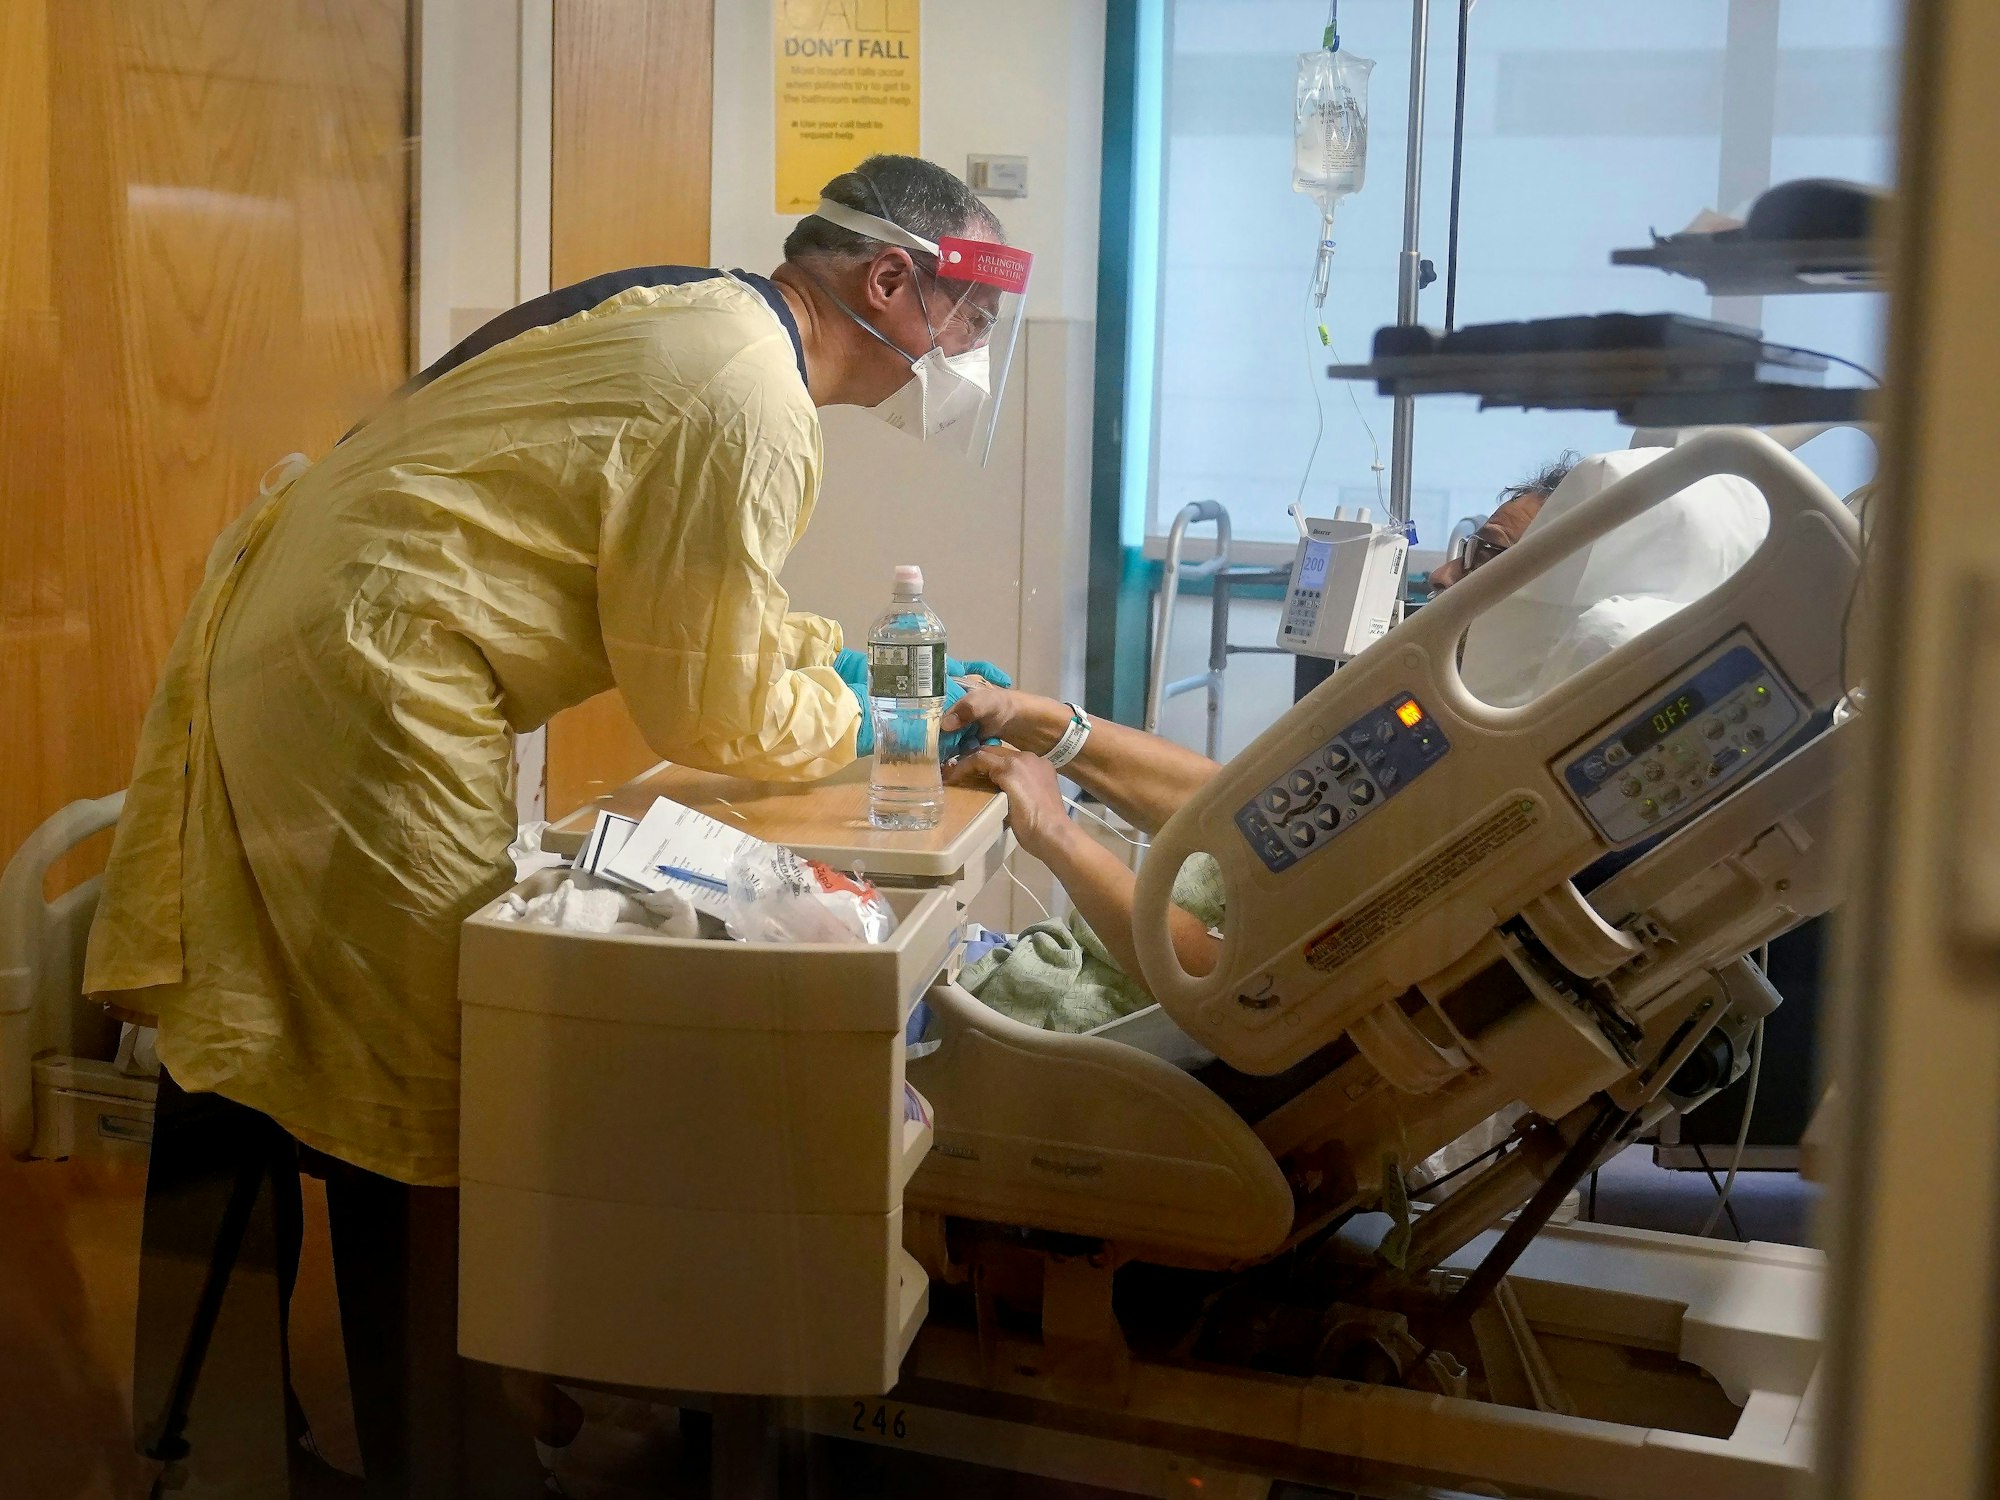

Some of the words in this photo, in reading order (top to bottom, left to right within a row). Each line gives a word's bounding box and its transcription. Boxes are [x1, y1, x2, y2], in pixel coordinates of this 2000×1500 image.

[784, 37, 853, 57] DON'T
[859, 39, 909, 59] FALL
[977, 254, 1025, 272] ARLINGTON
[977, 263, 1024, 281] SCIENTIFIC
[1304, 556, 1325, 572] 200
[1652, 695, 1690, 734] OFF
[853, 1400, 906, 1439] 246
